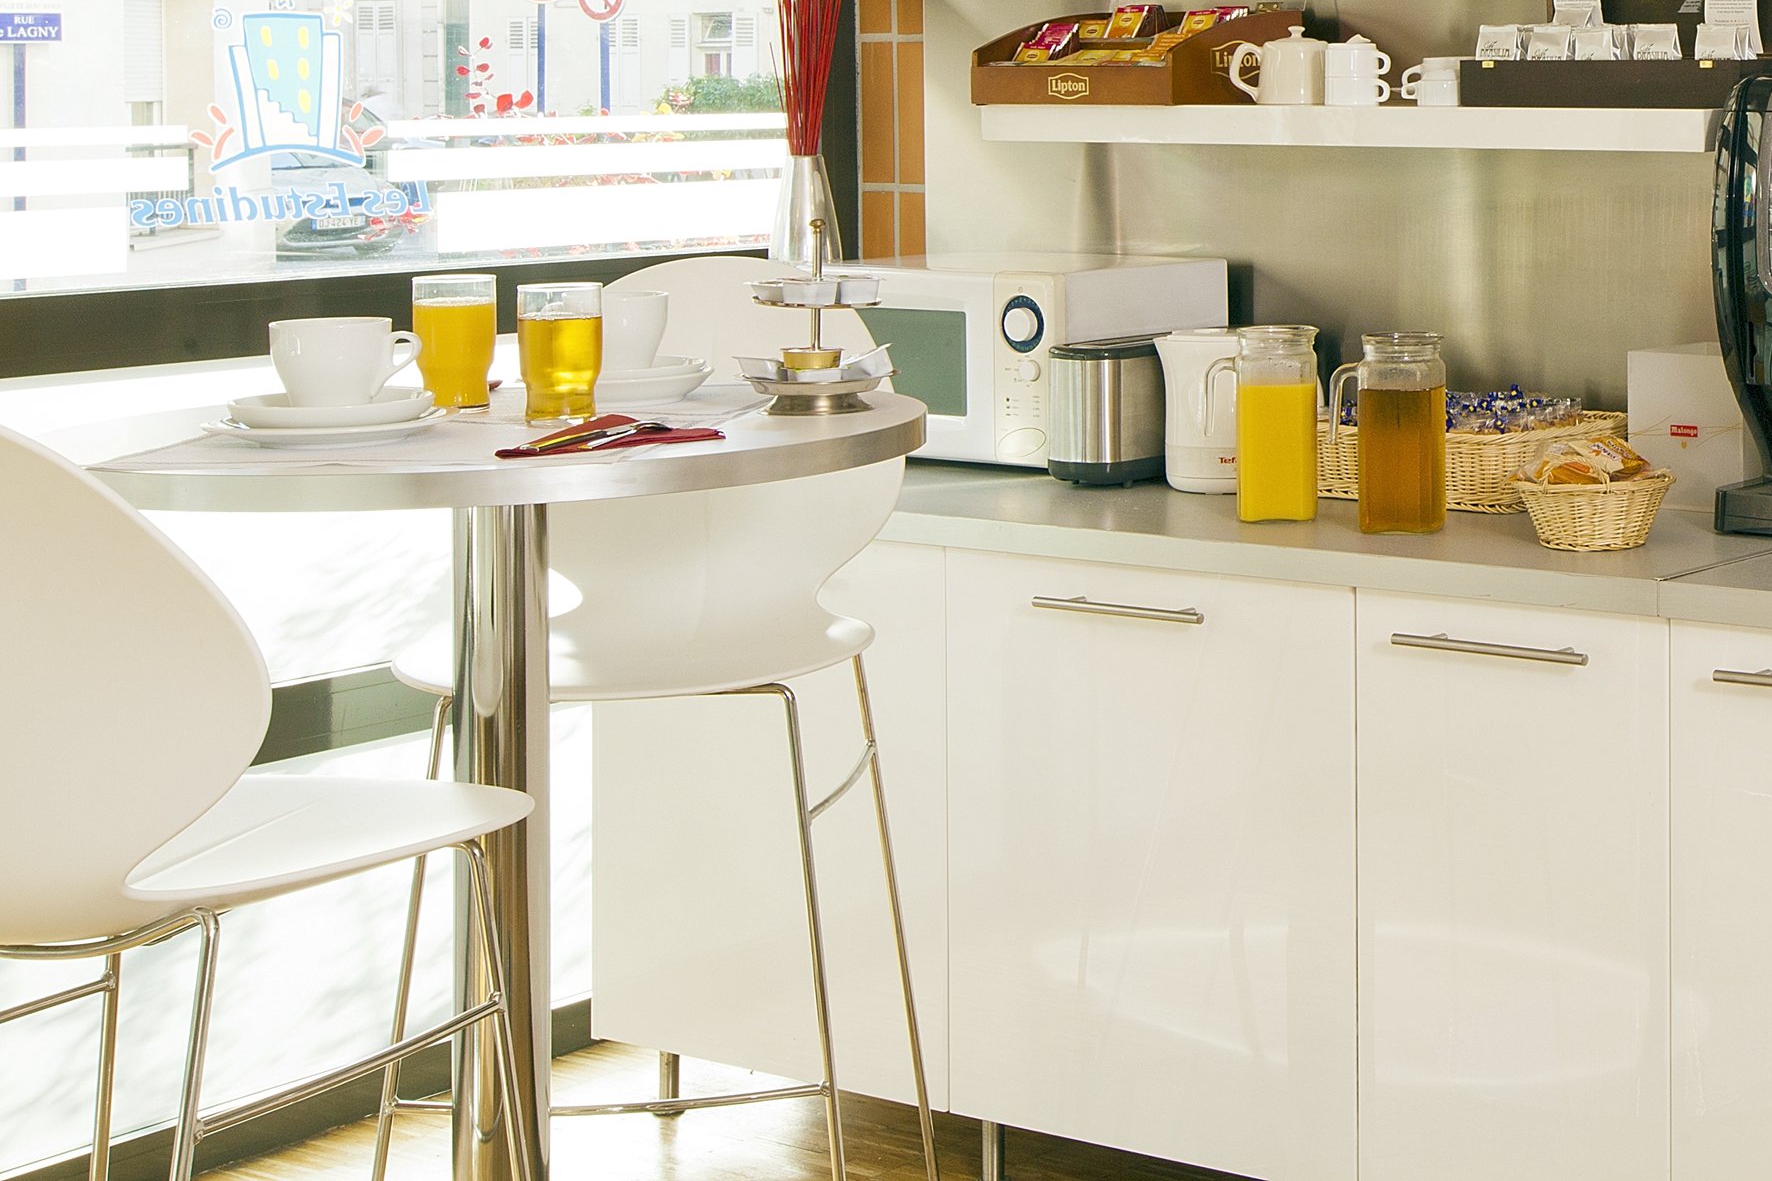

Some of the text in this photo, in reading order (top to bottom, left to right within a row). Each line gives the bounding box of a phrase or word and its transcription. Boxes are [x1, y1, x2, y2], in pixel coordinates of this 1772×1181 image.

[14, 15, 35, 25] RUE
[7, 26, 59, 38] LAGNY
[1215, 51, 1260, 67] Lion
[1051, 78, 1086, 94] Lipton
[1671, 426, 1698, 436] Malongo
[1218, 456, 1236, 464] Tef
